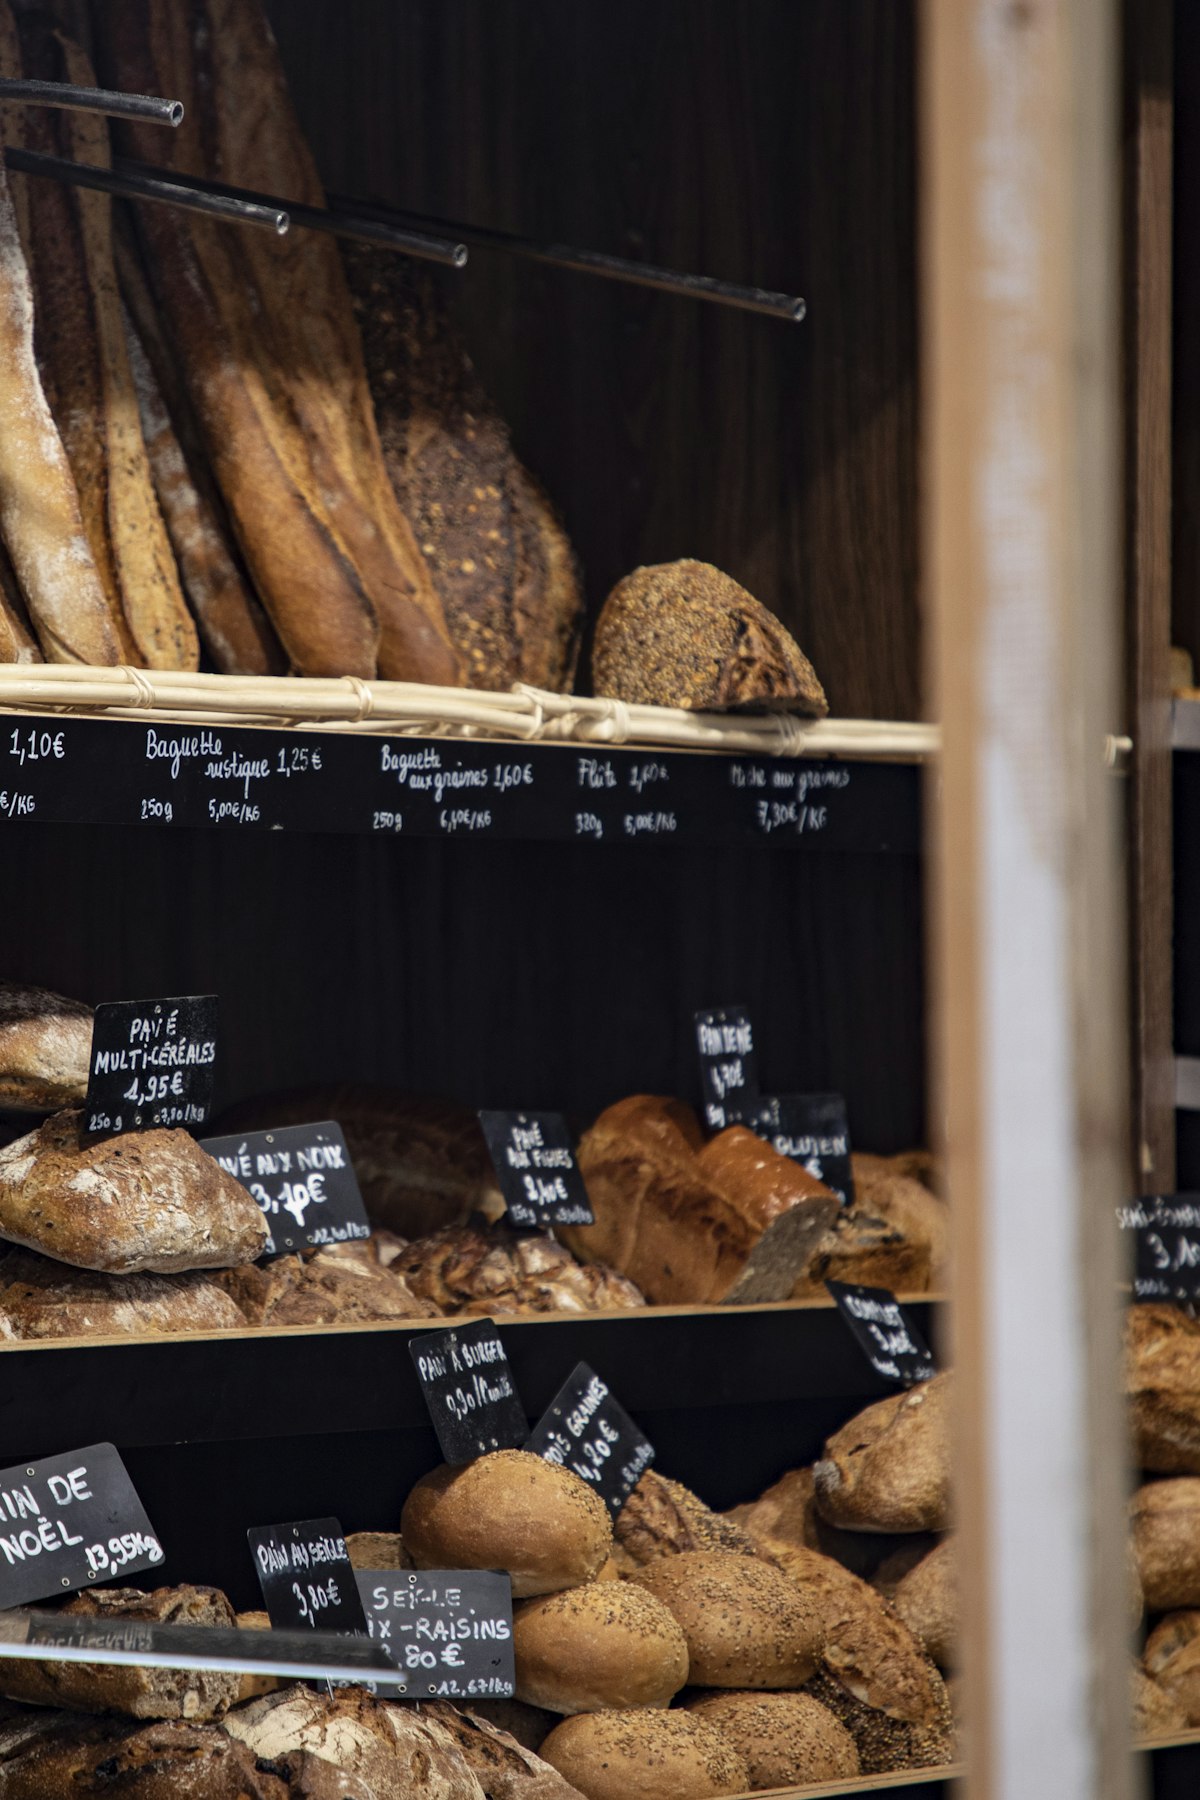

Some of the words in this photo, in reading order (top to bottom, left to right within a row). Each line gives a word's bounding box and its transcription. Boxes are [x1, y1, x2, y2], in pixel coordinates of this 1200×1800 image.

[9, 728, 65, 765] 1,10€
[146, 729, 223, 779] Baguette
[381, 744, 442, 783] Baguette
[205, 752, 270, 799] rustique
[409, 773, 432, 790] aux
[434, 761, 488, 802] graines
[494, 763, 534, 792] 1,60€
[129, 1009, 178, 1043] PAVÉ
[94, 1037, 215, 1075] MULTI-CÉRÉALES
[123, 1071, 183, 1106] 1,95€
[218, 1142, 252, 1177] AVÉ
[257, 1151, 293, 1175] AUX
[297, 1145, 346, 1171] NOIX
[775, 1134, 847, 1156] GLUTEN
[418, 1350, 447, 1381] PAIN
[461, 1339, 508, 1369] BURGER
[0, 1484, 41, 1522] IN
[47, 1466, 93, 1505] DE
[0, 1517, 84, 1564] NOËL
[257, 1540, 289, 1574] PAIN
[292, 1578, 342, 1628] 3,80€
